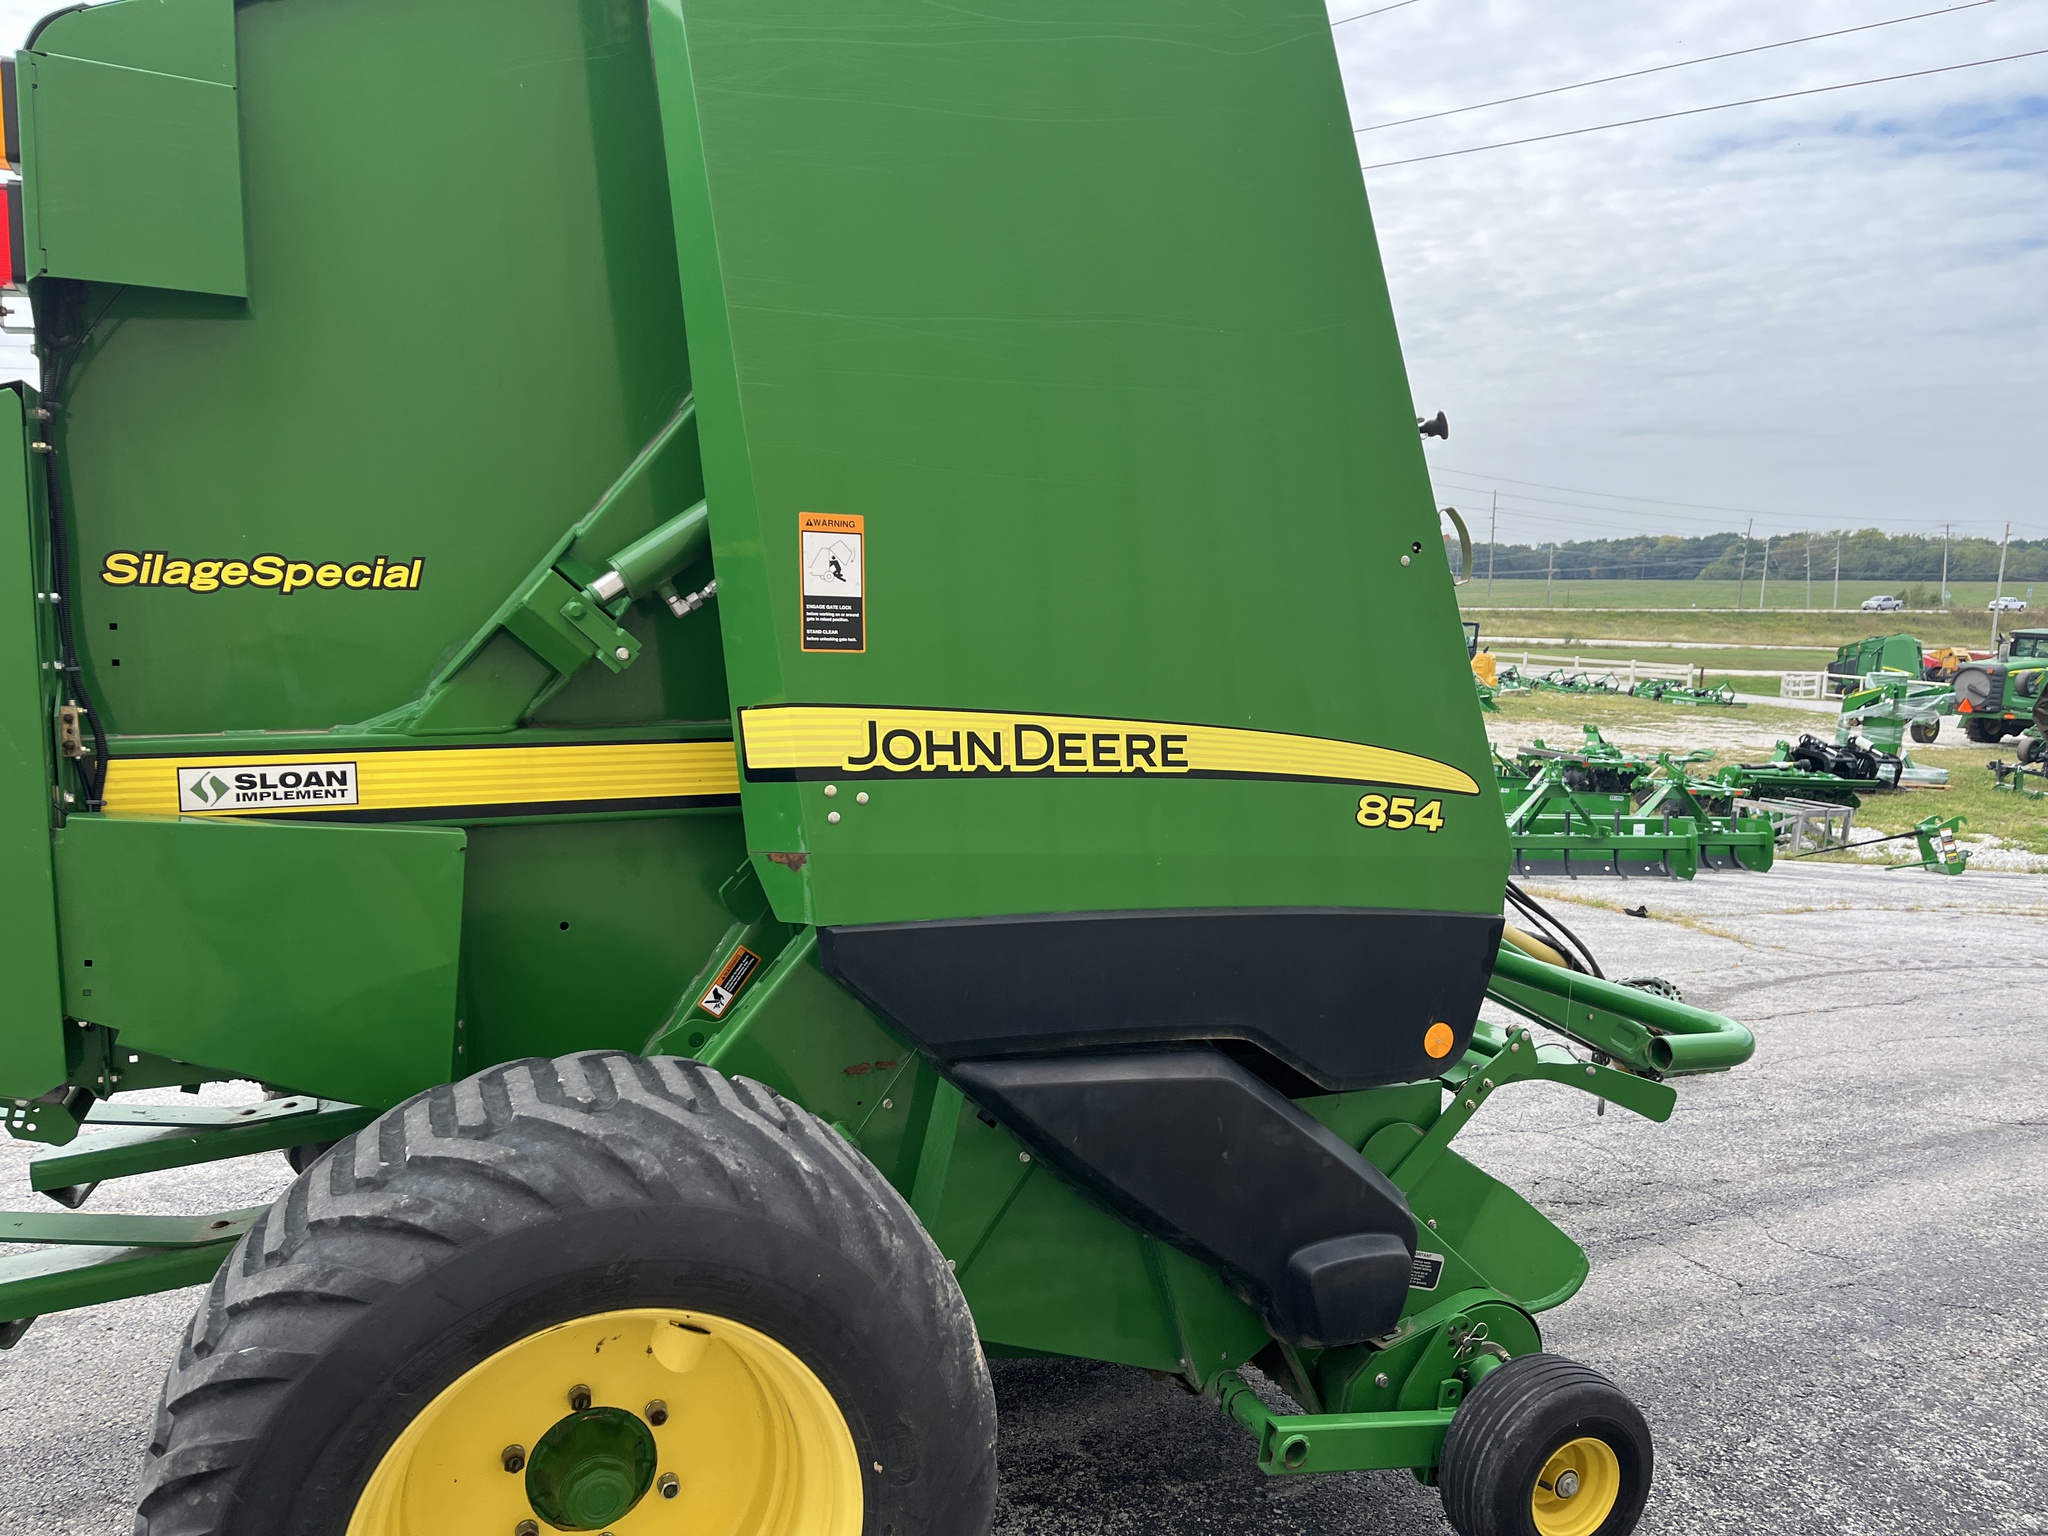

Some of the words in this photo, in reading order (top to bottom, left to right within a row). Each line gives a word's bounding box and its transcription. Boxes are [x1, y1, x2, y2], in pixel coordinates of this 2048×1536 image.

[813, 519, 855, 528] WARNING
[101, 551, 424, 594] SilageSpecial
[847, 719, 1002, 767] JOHN
[1013, 723, 1190, 768] DEERE
[235, 770, 347, 790] SLOAN
[235, 788, 348, 803] IMPLEMENT
[1356, 793, 1445, 833] 854
